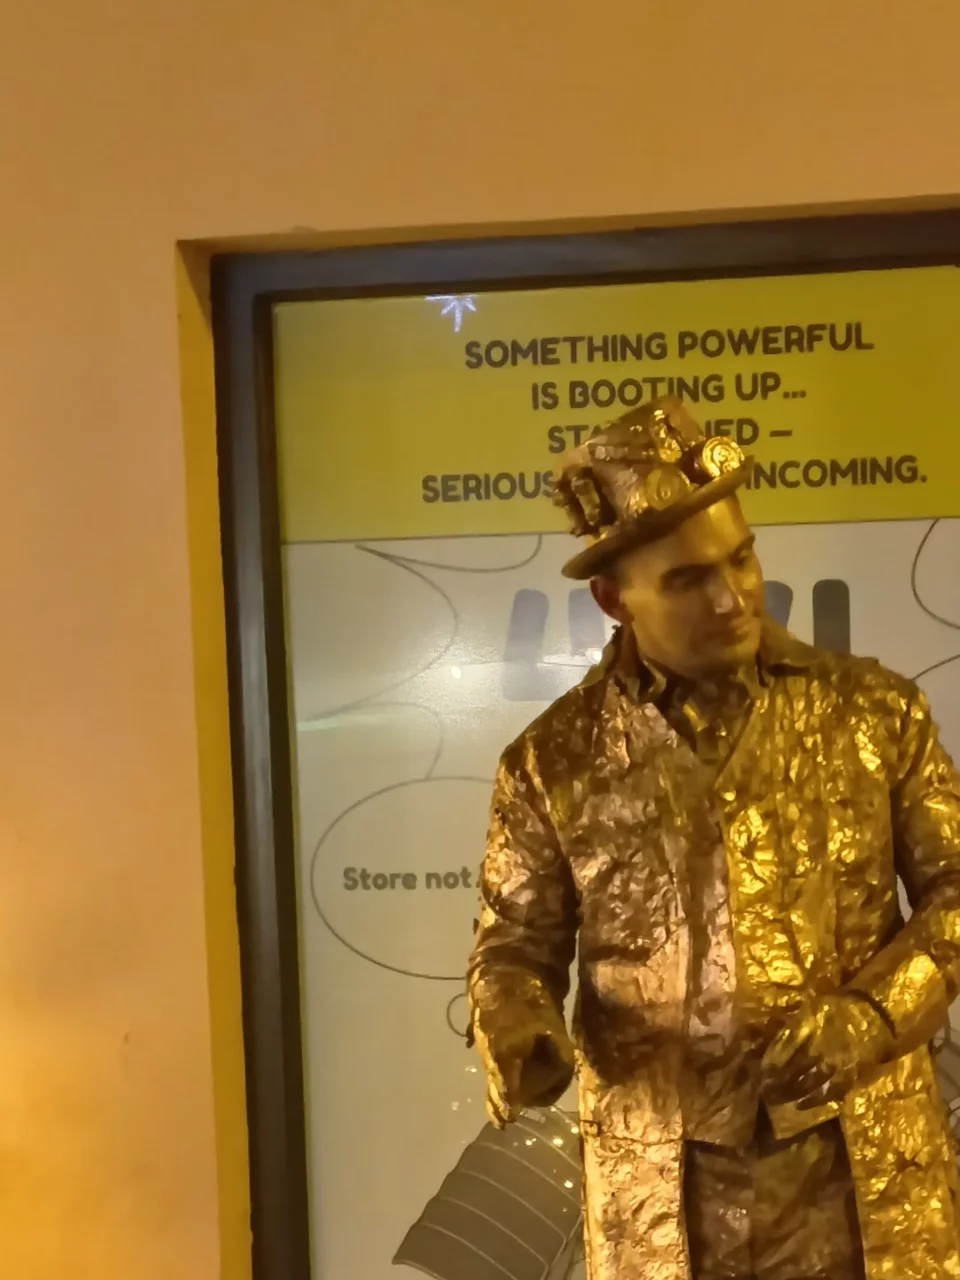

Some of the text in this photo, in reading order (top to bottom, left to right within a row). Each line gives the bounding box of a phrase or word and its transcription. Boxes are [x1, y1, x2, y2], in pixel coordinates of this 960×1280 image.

[464, 322, 875, 369] SOMETHING POWERFUL
[531, 372, 808, 410] IS BOOTING UP...
[343, 866, 472, 890] Store not
